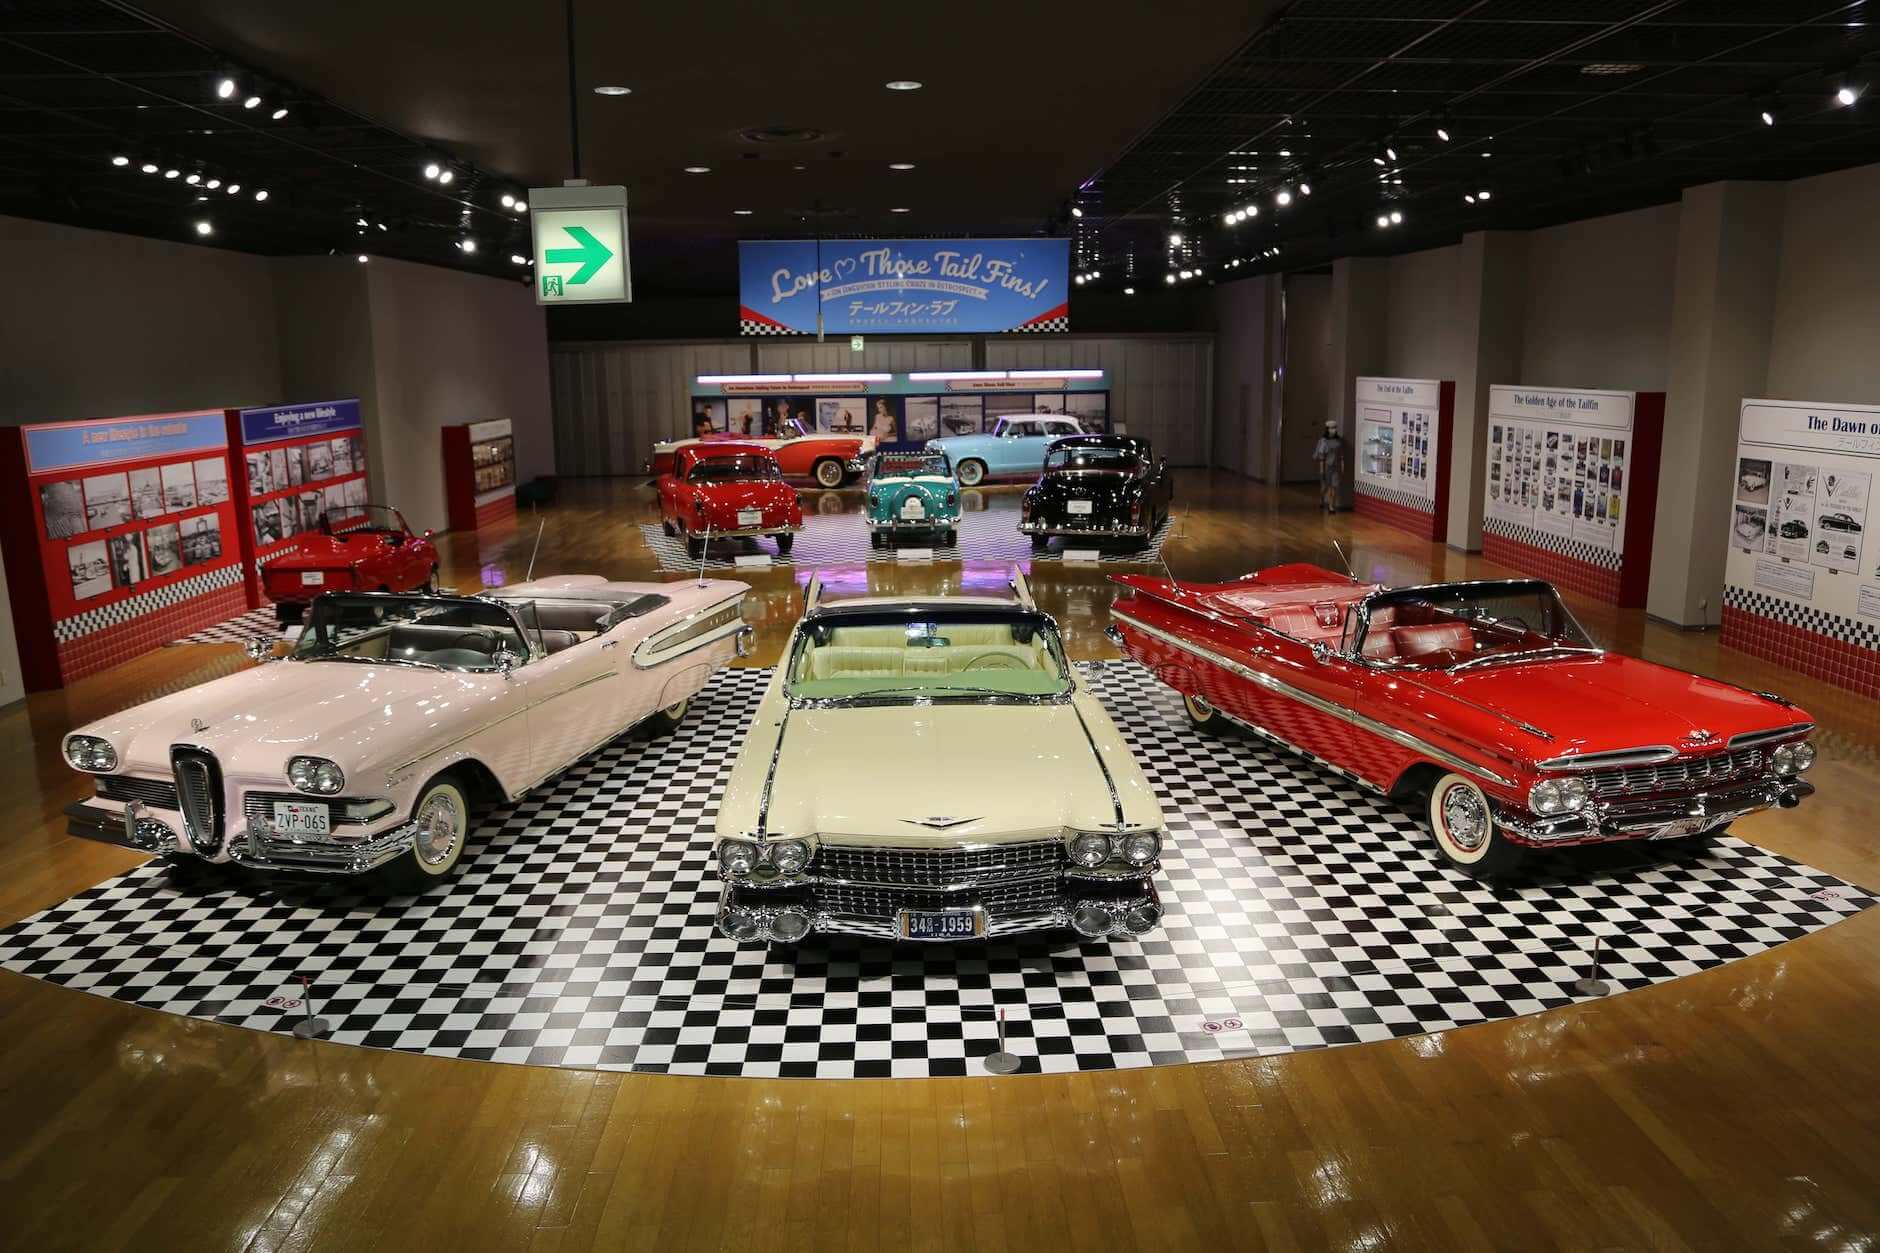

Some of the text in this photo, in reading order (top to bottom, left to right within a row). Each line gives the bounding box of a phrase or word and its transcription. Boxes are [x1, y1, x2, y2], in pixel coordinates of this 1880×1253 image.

[772, 247, 1049, 303] Love Those Tail Fins!
[848, 300, 961, 316] テールフィン・ラブ
[1514, 394, 1523, 405] The
[1559, 398, 1565, 407] of
[1566, 398, 1576, 409] the
[1578, 398, 1599, 410] Tailfin
[1807, 415, 1828, 431] The
[1832, 417, 1866, 433] Dawn
